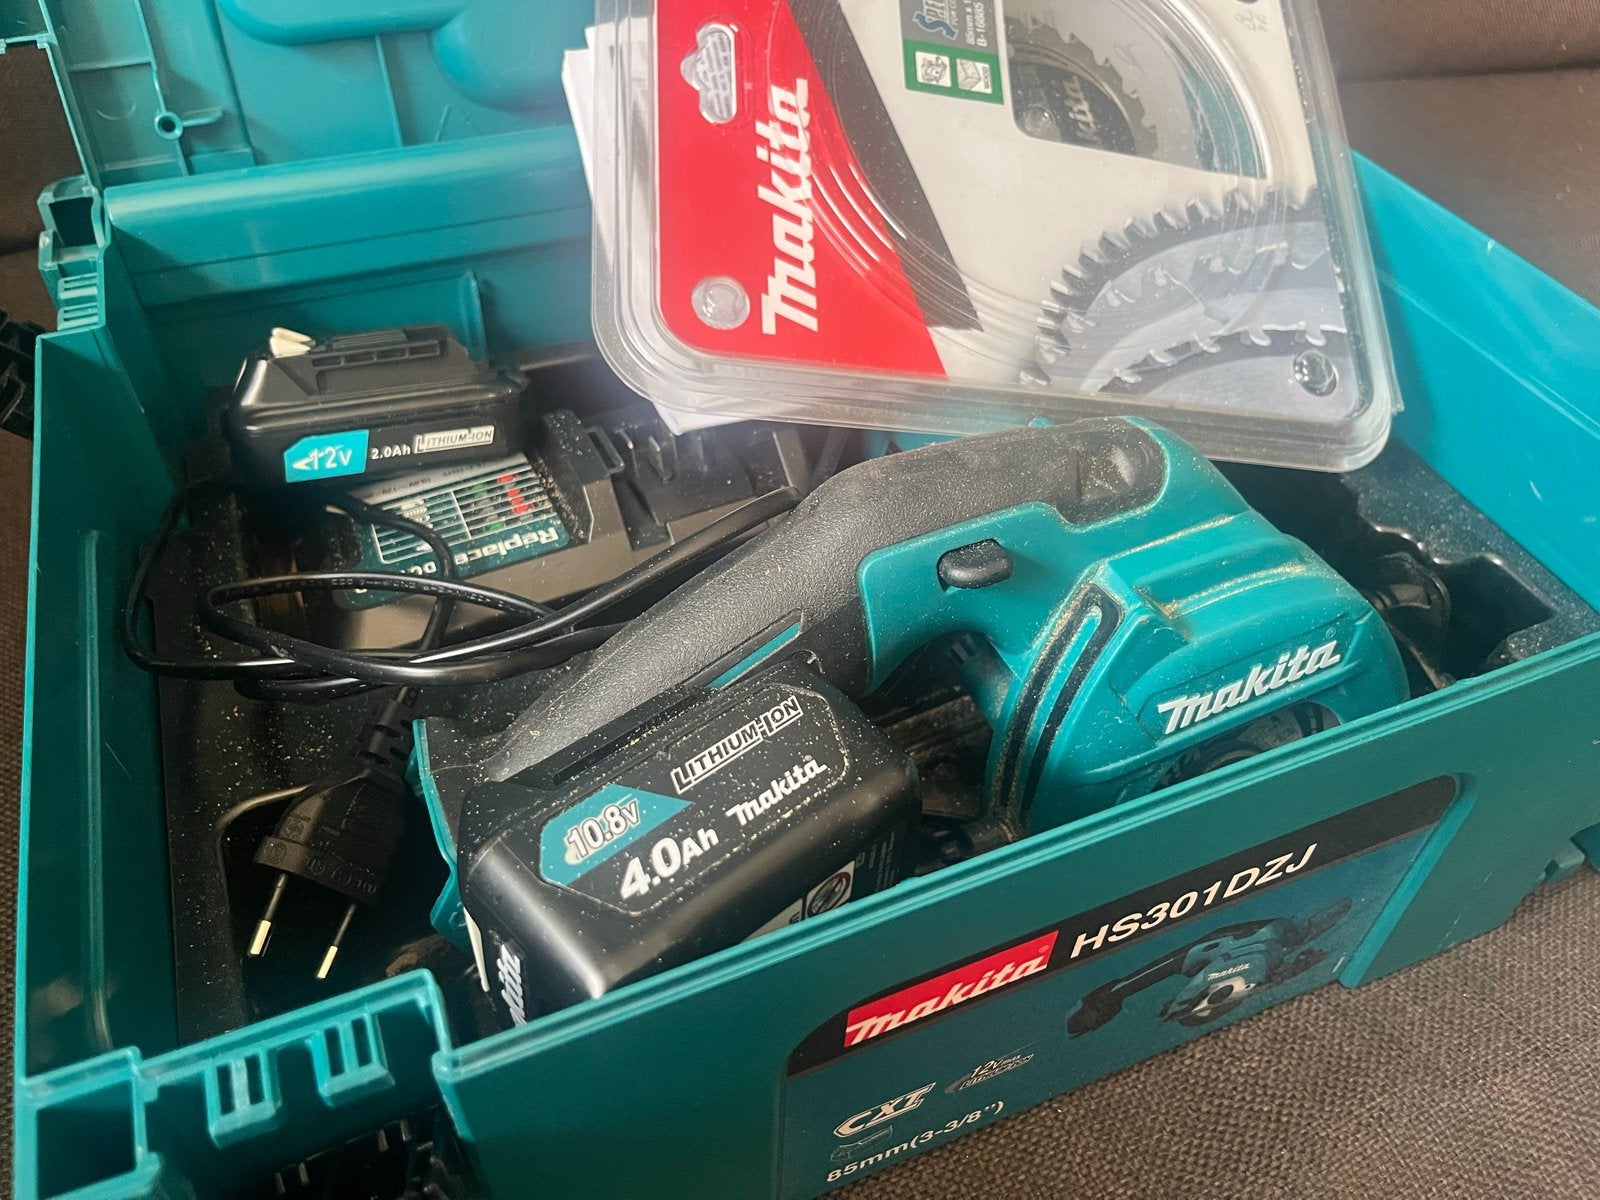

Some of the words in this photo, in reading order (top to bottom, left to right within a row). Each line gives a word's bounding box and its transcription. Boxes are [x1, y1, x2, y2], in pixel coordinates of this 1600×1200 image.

[370, 444, 412, 460] 2.0Ah
[413, 425, 495, 454] LITHIUM-ION
[453, 526, 560, 566] Replace
[670, 695, 804, 795] LITHIUM-ION
[620, 827, 719, 900] 4.0Ah
[1069, 843, 1318, 959] HS301DZJ
[832, 1081, 938, 1138] CXT
